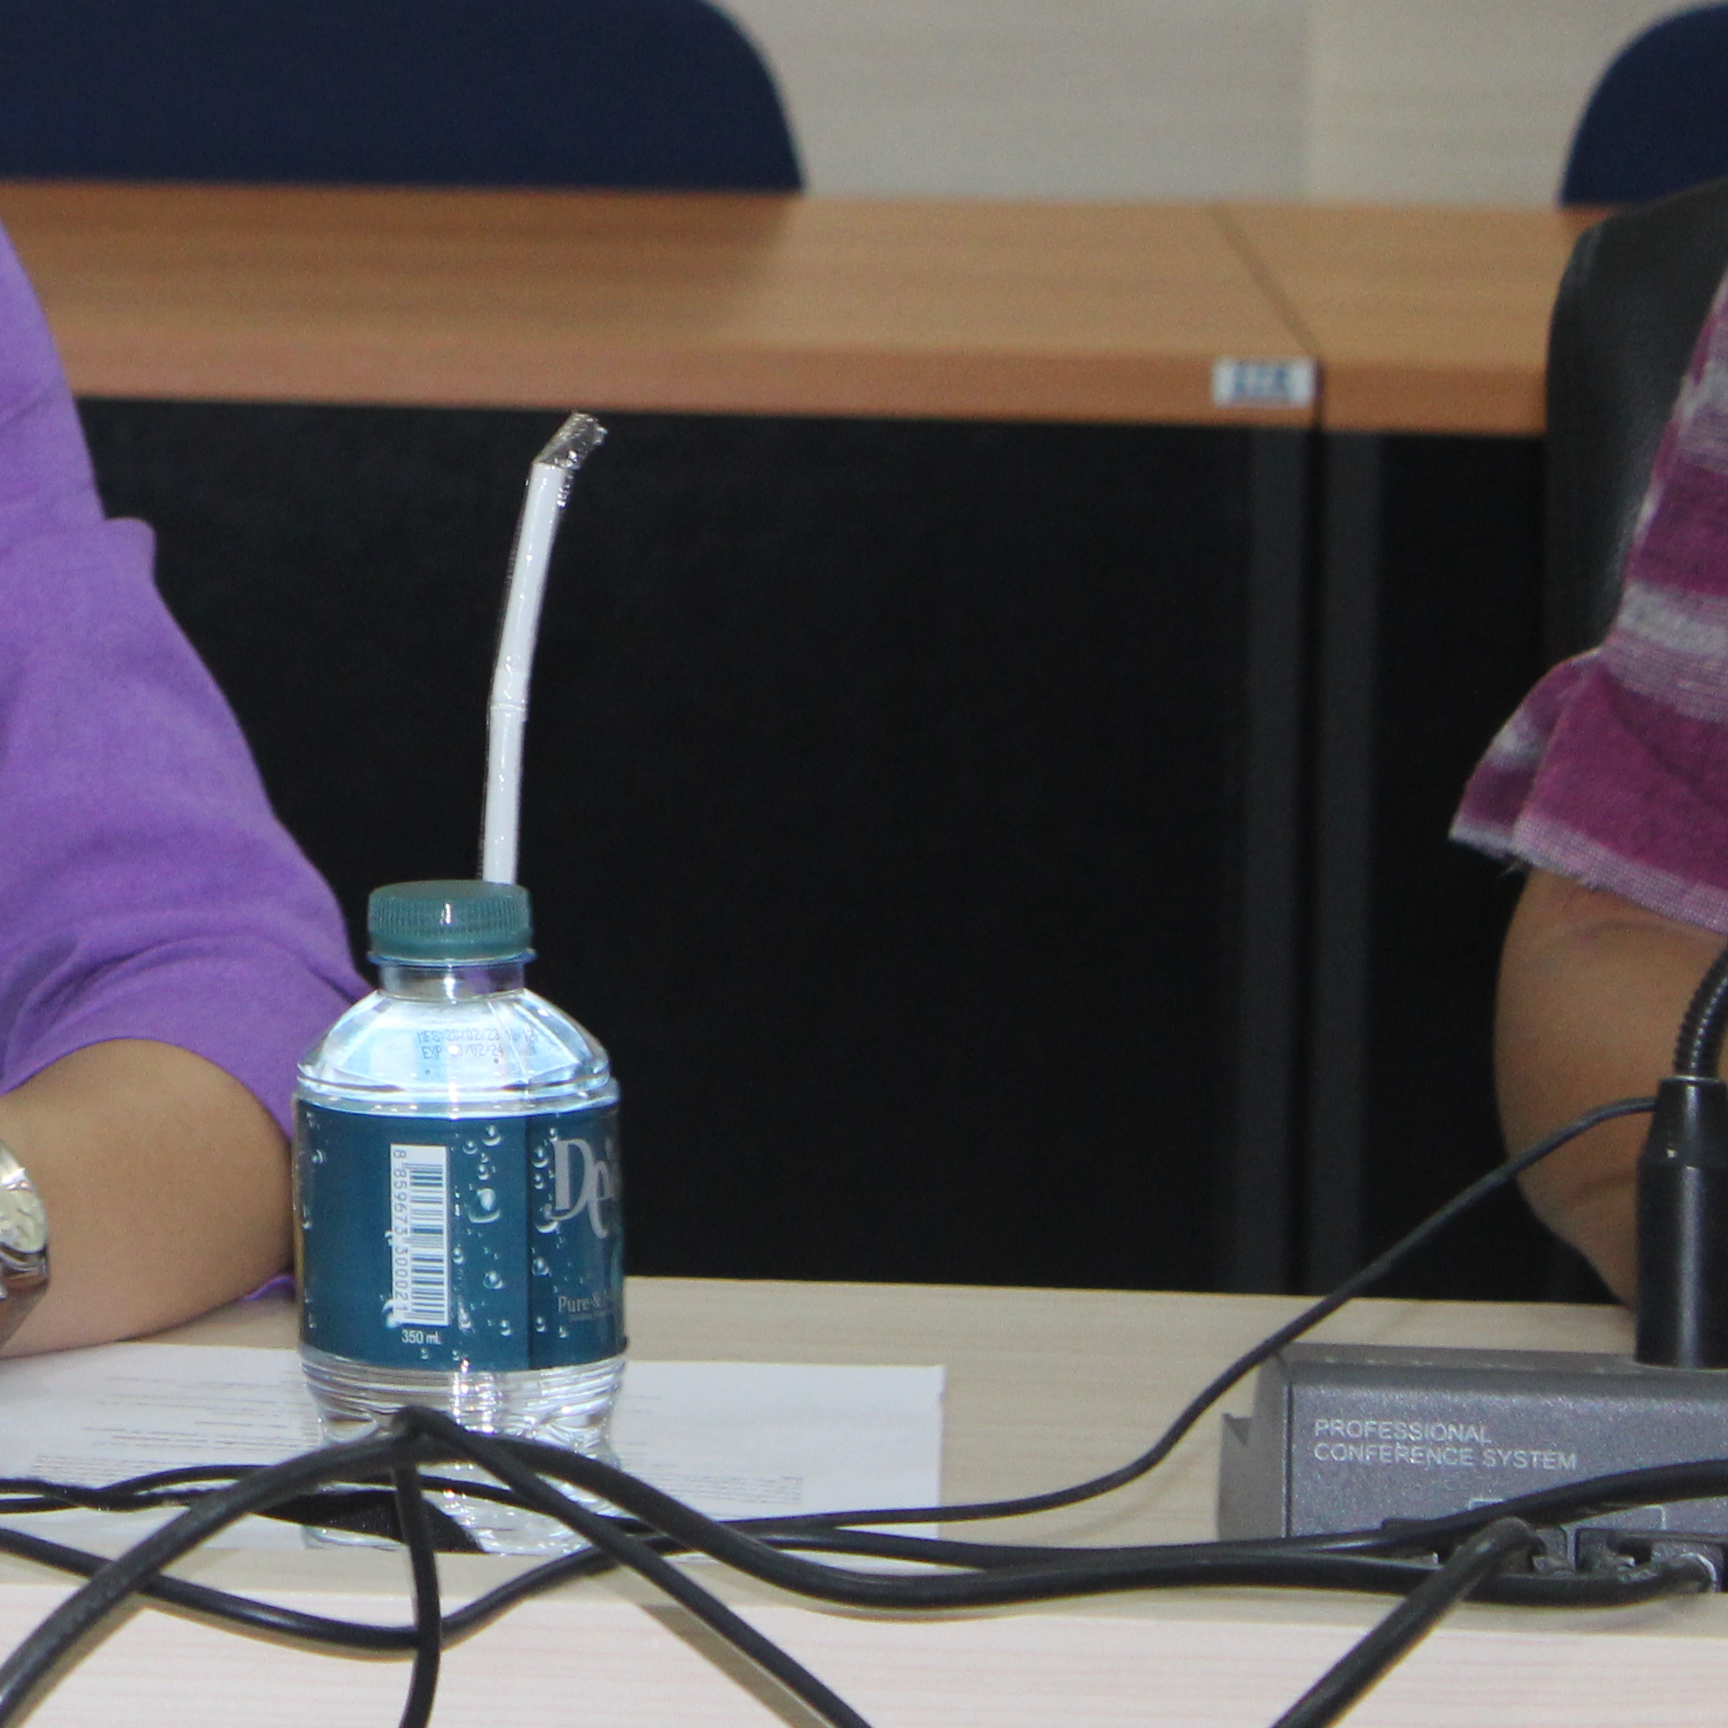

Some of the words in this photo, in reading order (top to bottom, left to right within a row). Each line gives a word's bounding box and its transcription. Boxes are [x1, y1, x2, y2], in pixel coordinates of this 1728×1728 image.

[401, 1330, 423, 1344] 350
[426, 1332, 442, 1345] mL
[1314, 1419, 1493, 1446] PROFESSIONAL
[1314, 1443, 1474, 1467] CONFERENCE
[1482, 1448, 1577, 1471] SYSTEM
